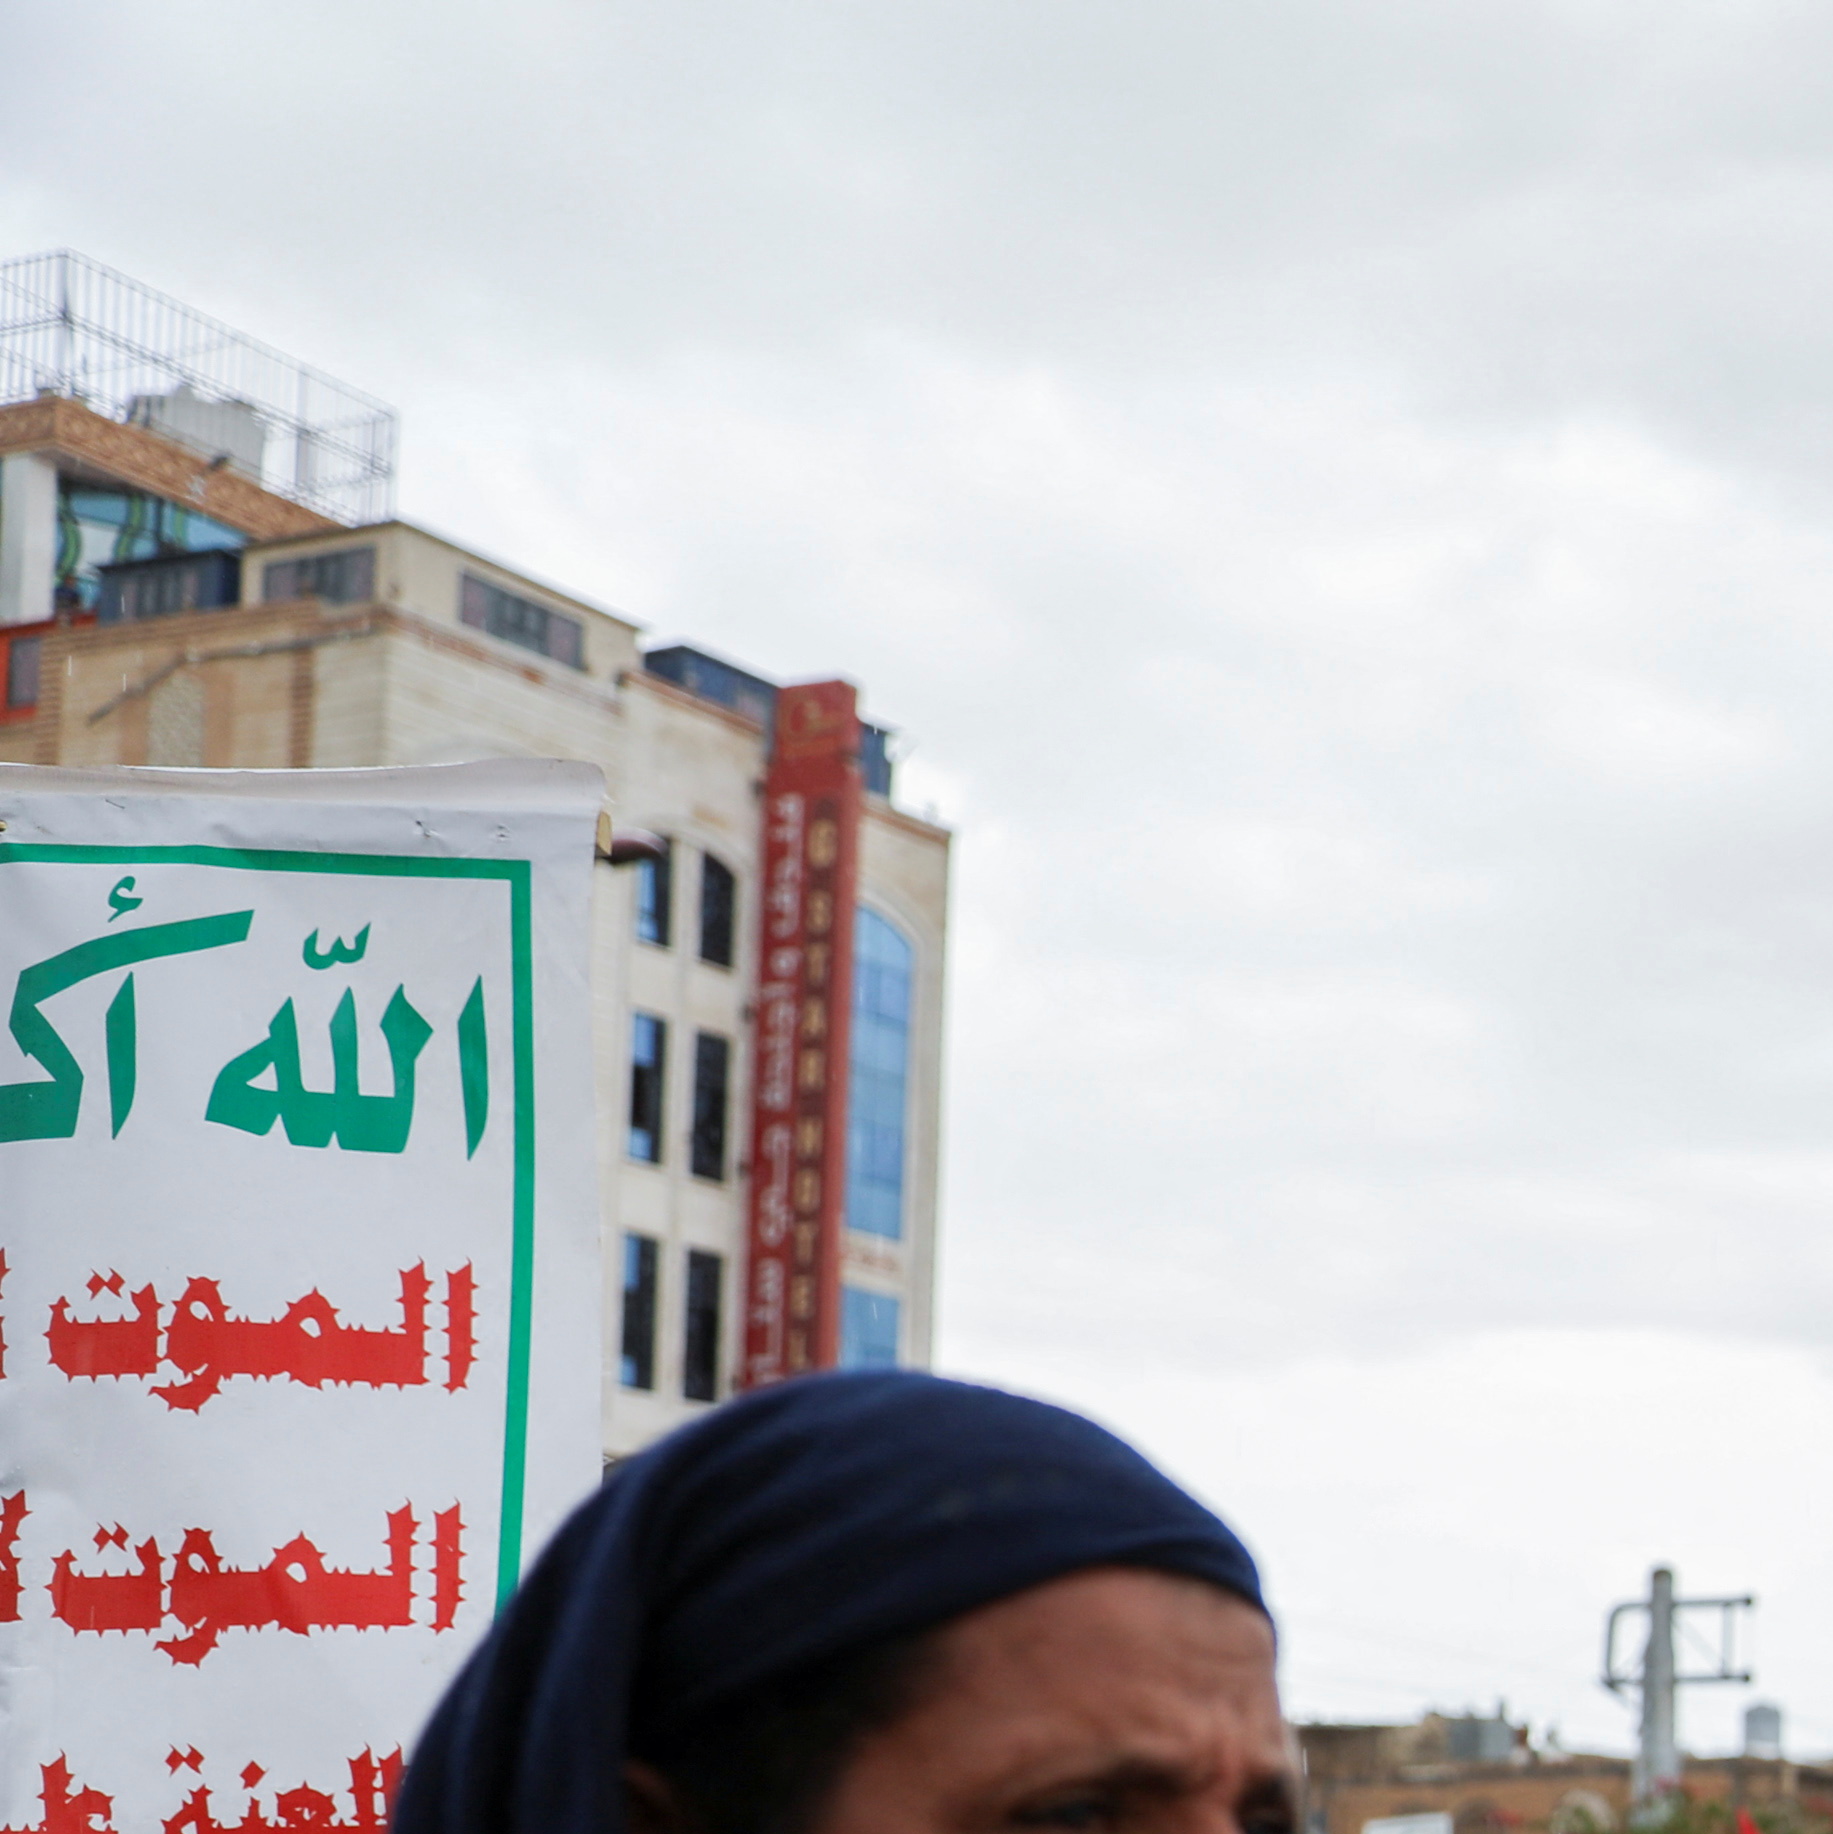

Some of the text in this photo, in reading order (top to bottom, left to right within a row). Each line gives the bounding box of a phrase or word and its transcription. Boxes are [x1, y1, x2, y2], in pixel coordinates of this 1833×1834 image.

[0, 874, 256, 1144] أك
[798, 886, 834, 1097] STAR
[43, 1255, 480, 1415] الموت
[43, 1497, 468, 1669] الموت
